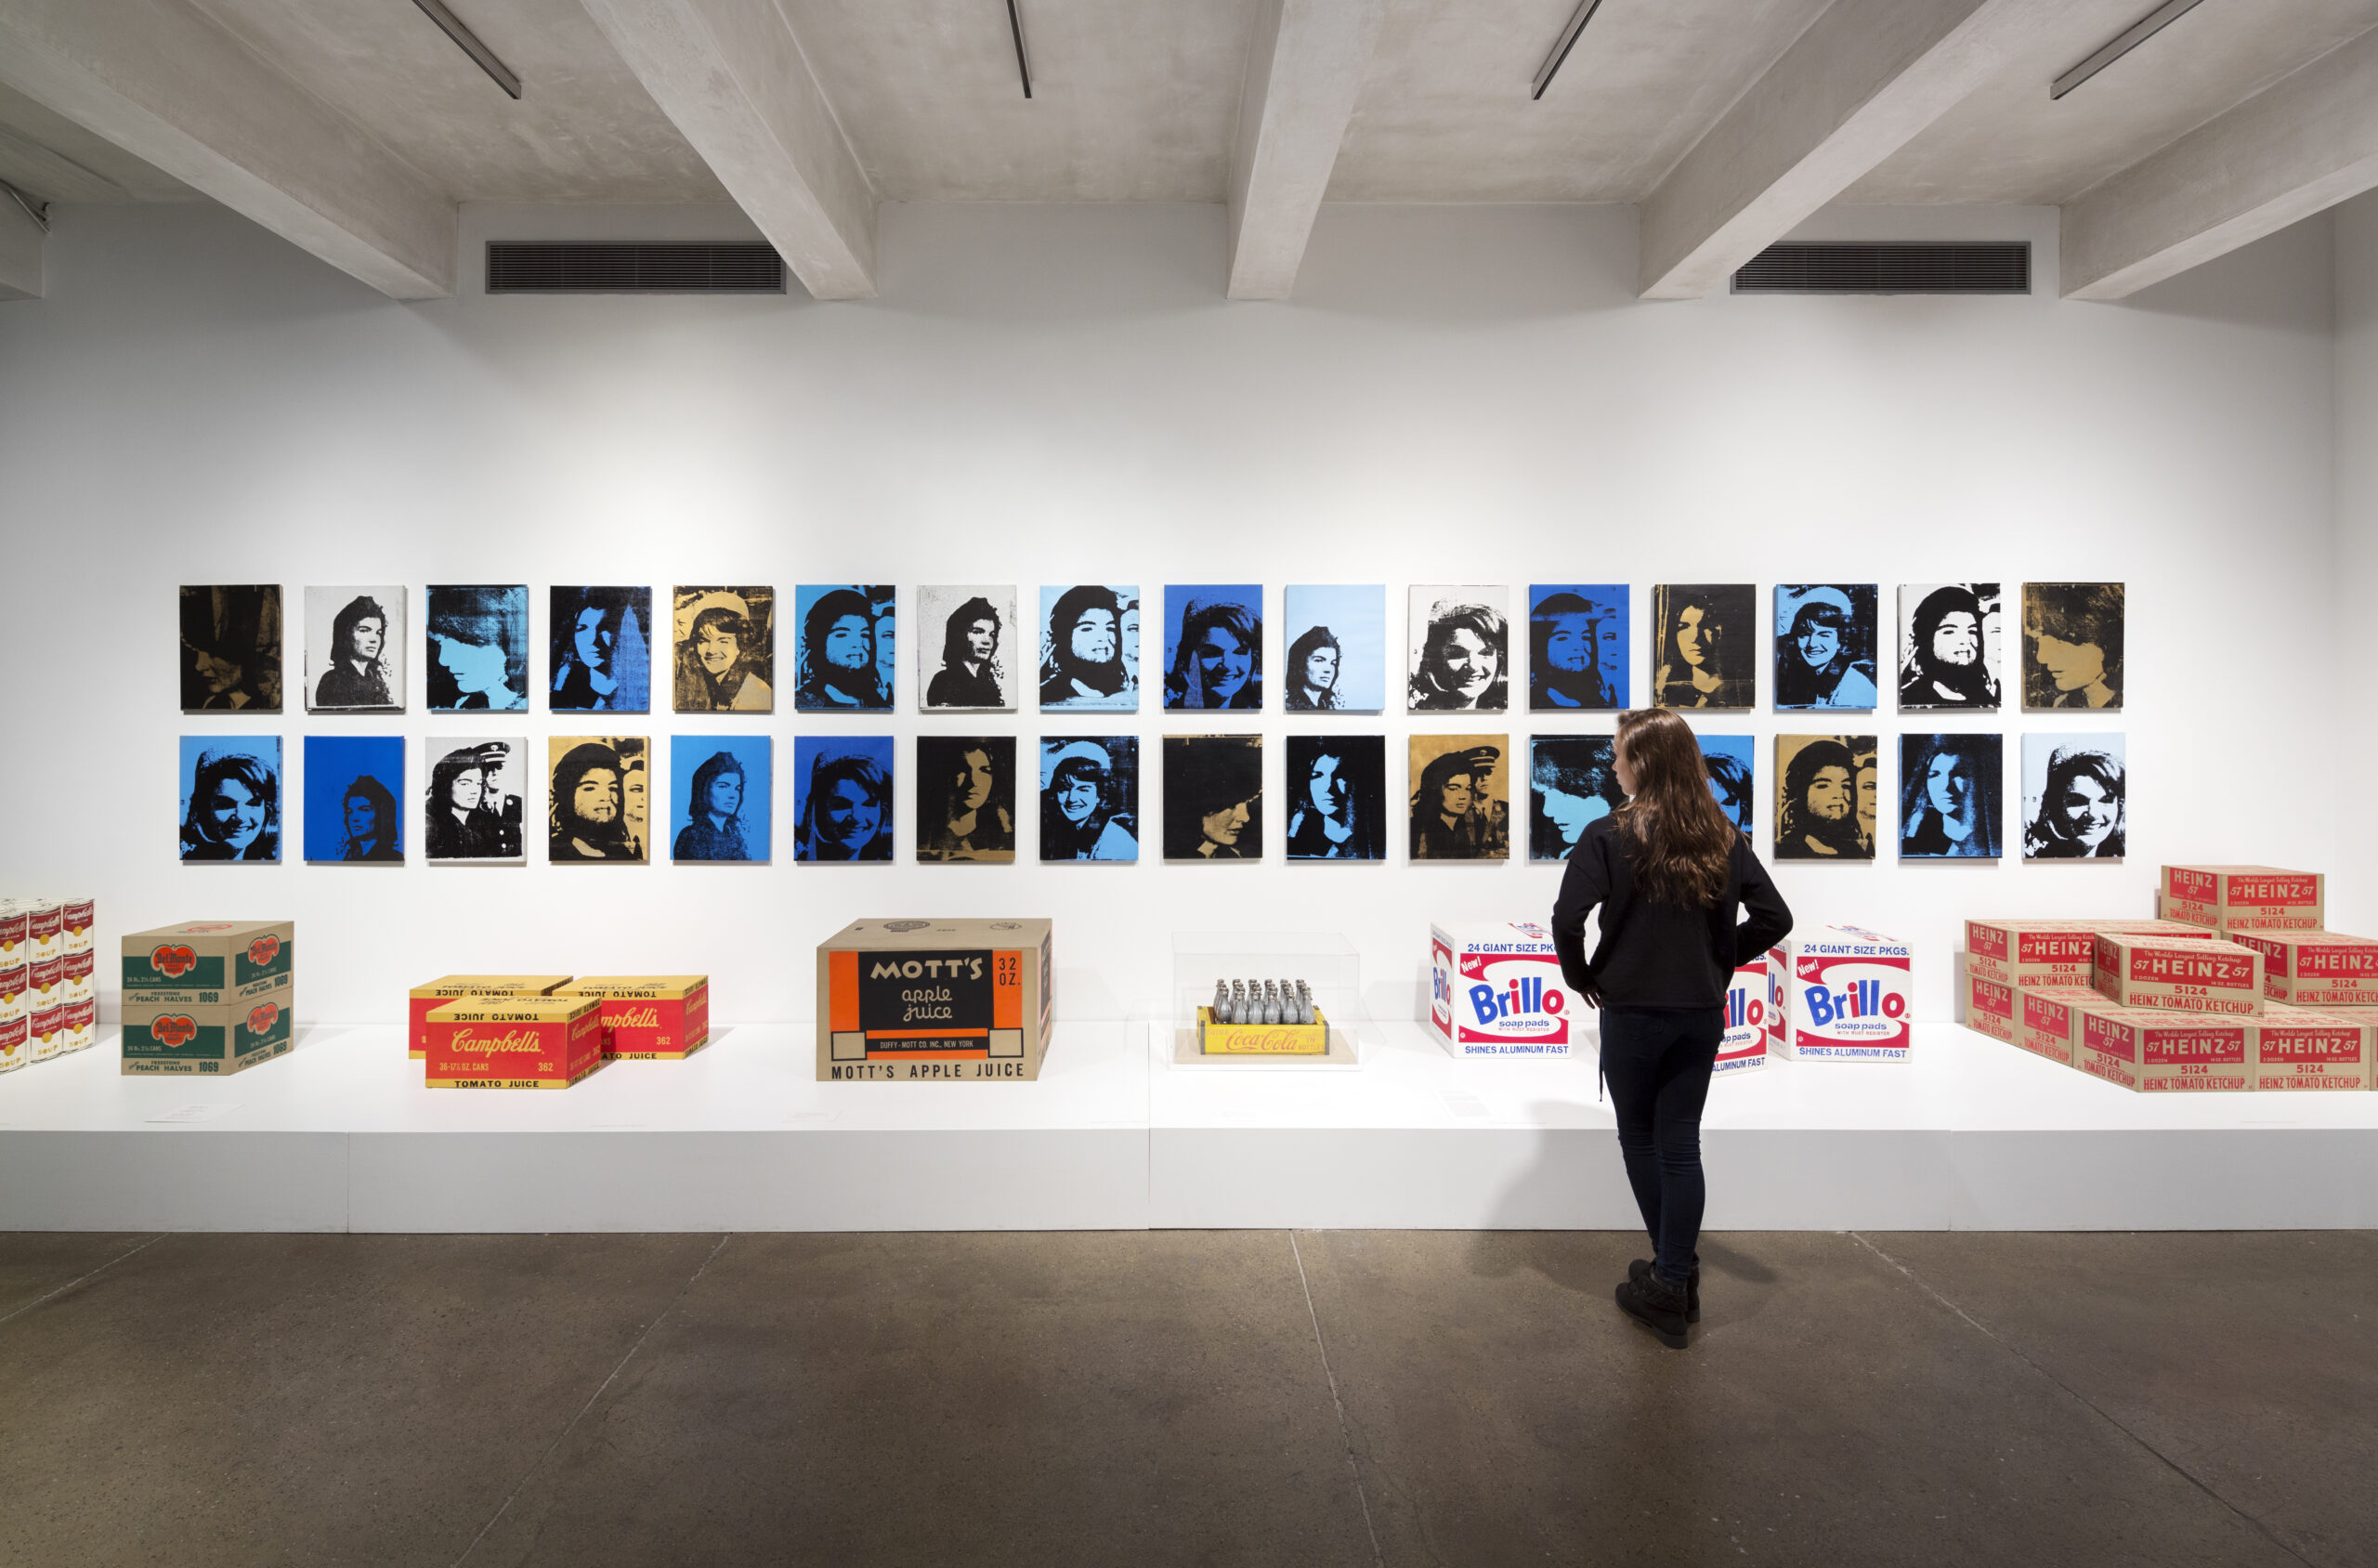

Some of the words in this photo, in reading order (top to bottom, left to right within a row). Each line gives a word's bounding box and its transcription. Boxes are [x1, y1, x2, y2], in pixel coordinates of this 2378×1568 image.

[2175, 868, 2213, 888] HEINZ
[2230, 887, 2241, 895] 57
[2244, 884, 2300, 898] HEINZ
[2302, 887, 2314, 895] 57
[2182, 901, 2203, 911] 5124
[2261, 908, 2285, 916] 5124
[2170, 908, 2190, 921] TOMATO
[2191, 911, 2217, 927] KETCHUP
[2228, 919, 2249, 929] HEINZ
[2252, 919, 2282, 929] TOMATO
[2283, 919, 2318, 929] KETCHUP
[1972, 925, 2004, 944] HEINZ
[69, 939, 88, 948] SOUP
[1468, 944, 1480, 952] 24
[1483, 944, 1513, 952] GIANT
[1516, 944, 1537, 952] SIZE
[2021, 944, 2033, 953] 57
[2035, 941, 2092, 955] HEINZ
[1804, 945, 1816, 953] 24
[1820, 945, 1850, 954] GIANT
[1854, 946, 1876, 955] SIZE
[1879, 947, 1909, 956] PKGS.
[869, 957, 984, 980] MOTT'S
[999, 958, 1017, 971] 32
[1461, 956, 1482, 973] New!
[1798, 960, 1819, 976] New!
[1979, 957, 1996, 968] 5124
[2052, 964, 2076, 973] 5124
[2134, 960, 2149, 971] 57
[2152, 959, 2229, 979] HEINZ
[2232, 967, 2250, 978] 57
[2299, 958, 2312, 967] 57
[2315, 955, 2373, 970] HEINZ
[274, 974, 288, 987] 1069
[999, 973, 1021, 987] OZ.
[1433, 967, 1451, 1005] Brillo
[2019, 976, 2040, 987] HEINZ
[2043, 976, 2072, 987] TOMATO
[69, 988, 88, 999] SOUP
[199, 992, 218, 1002] 1069
[902, 986, 952, 1004] apple
[1976, 981, 2008, 1002] HEINZ
[2175, 986, 2208, 997] 5124
[2296, 991, 2319, 1002] HEINZ
[2322, 991, 2354, 1002] TOMATO
[37, 997, 57, 1007] SOUP
[1469, 977, 1564, 1026] Brillo
[1804, 980, 1906, 1026] Brillo
[1987, 998, 1996, 1007] 57
[2130, 994, 2159, 1007] HEINZ
[2162, 997, 2202, 1010] TOMATO
[2206, 1000, 2254, 1013] KETCHUP
[903, 1003, 953, 1022] juice
[2029, 998, 2064, 1020] HEINZ
[601, 1007, 660, 1033] mpbell's
[1499, 1020, 1523, 1028] soap
[1525, 1019, 1549, 1028] pads
[1983, 1013, 2001, 1025] 5124
[2041, 1015, 2051, 1025] 57
[1835, 1023, 1861, 1032] soap
[1862, 1022, 1887, 1031] pads
[2088, 1016, 2129, 1042] HEINZ
[70, 1037, 89, 1047] SOUP
[451, 1028, 542, 1057] Campbell's
[657, 1037, 671, 1045] 362
[1732, 1032, 1751, 1042] pads
[2035, 1031, 2056, 1044] 5124
[2103, 1037, 2114, 1048] 57
[38, 1045, 58, 1055] SOUP
[880, 1040, 917, 1049] DUFFY-MOTT
[918, 1040, 928, 1049] CO.
[944, 1040, 958, 1049] NEW
[959, 1039, 973, 1049] YORK
[2147, 1042, 2160, 1052] 57
[2162, 1039, 2225, 1054] HEINZ
[2227, 1041, 2241, 1051] 57
[2262, 1040, 2277, 1051] 57
[2279, 1039, 2342, 1053] HEINZ
[2343, 1040, 2358, 1051] 57
[1799, 1048, 1832, 1056] SHINES
[1834, 1048, 1880, 1057] ALUMINUM
[1882, 1050, 1907, 1058] FAST
[2097, 1052, 2120, 1067] 5124
[199, 1062, 218, 1072] 1069
[473, 1063, 489, 1071] CANS
[538, 1063, 554, 1071] 362
[1712, 1059, 1746, 1071] ALUMINUM
[1747, 1057, 1766, 1068] FAST
[2181, 1065, 2208, 1074] 5124
[2296, 1065, 2323, 1073] 5124
[831, 1065, 895, 1079] MOTT'S
[909, 1064, 961, 1078] APPLE
[976, 1063, 1025, 1077] JUICE
[2084, 1059, 2106, 1077] TOMATO
[2108, 1065, 2136, 1088] KETCHUP
[2144, 1078, 2168, 1091] HEINZ
[2171, 1078, 2204, 1091] TOMATO
[2206, 1078, 2245, 1090] KETCHUP
[2259, 1077, 2283, 1090] HEINZ
[2286, 1077, 2319, 1090] TOMATO
[2322, 1077, 2360, 1090] KETCHUP
